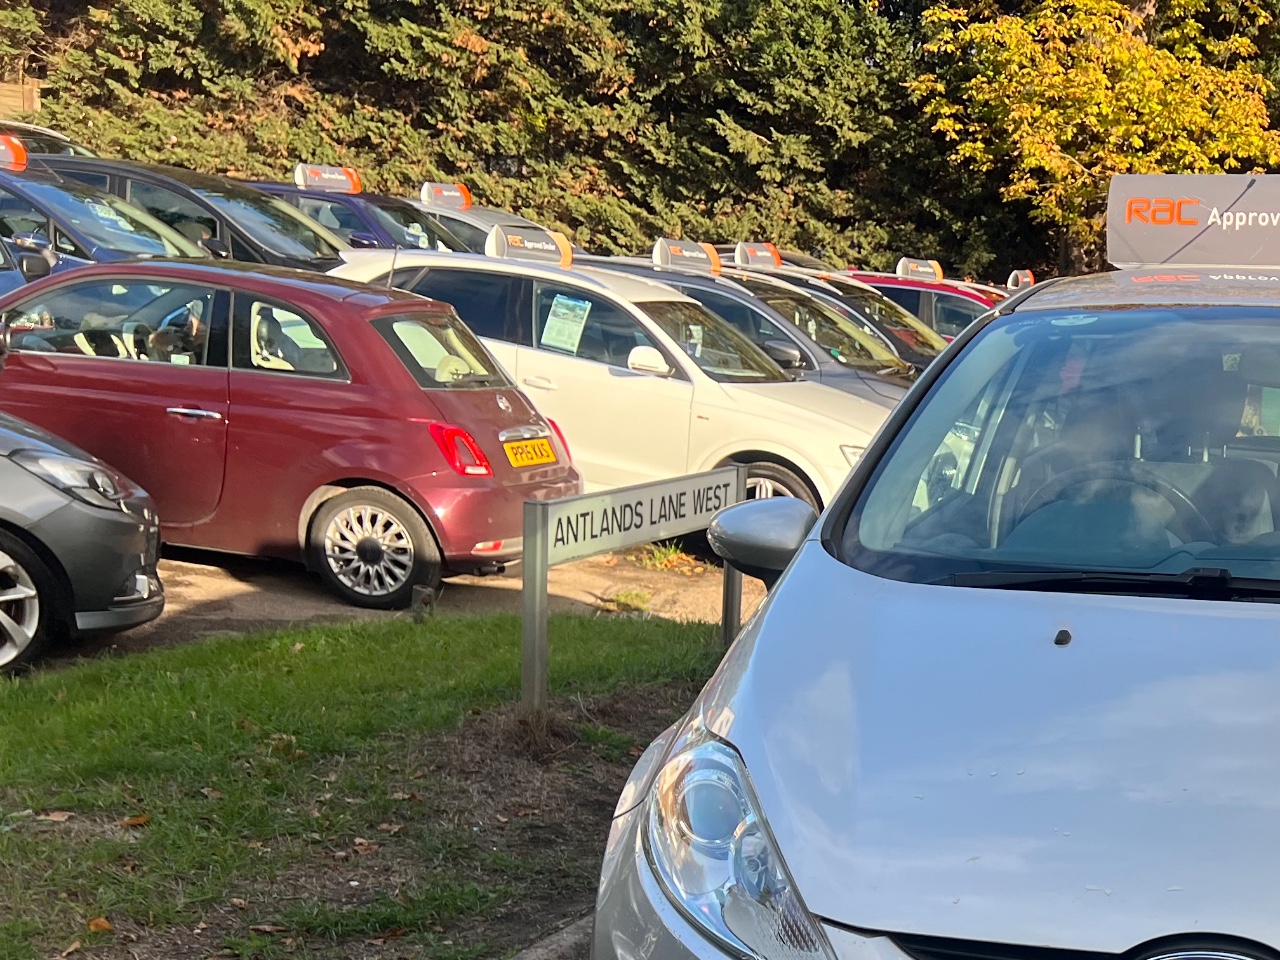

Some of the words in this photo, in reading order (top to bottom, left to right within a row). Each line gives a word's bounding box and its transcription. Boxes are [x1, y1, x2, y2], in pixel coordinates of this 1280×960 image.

[553, 501, 644, 548] ANTLANDS
[649, 491, 687, 526] LANE
[692, 482, 731, 515] WEST
